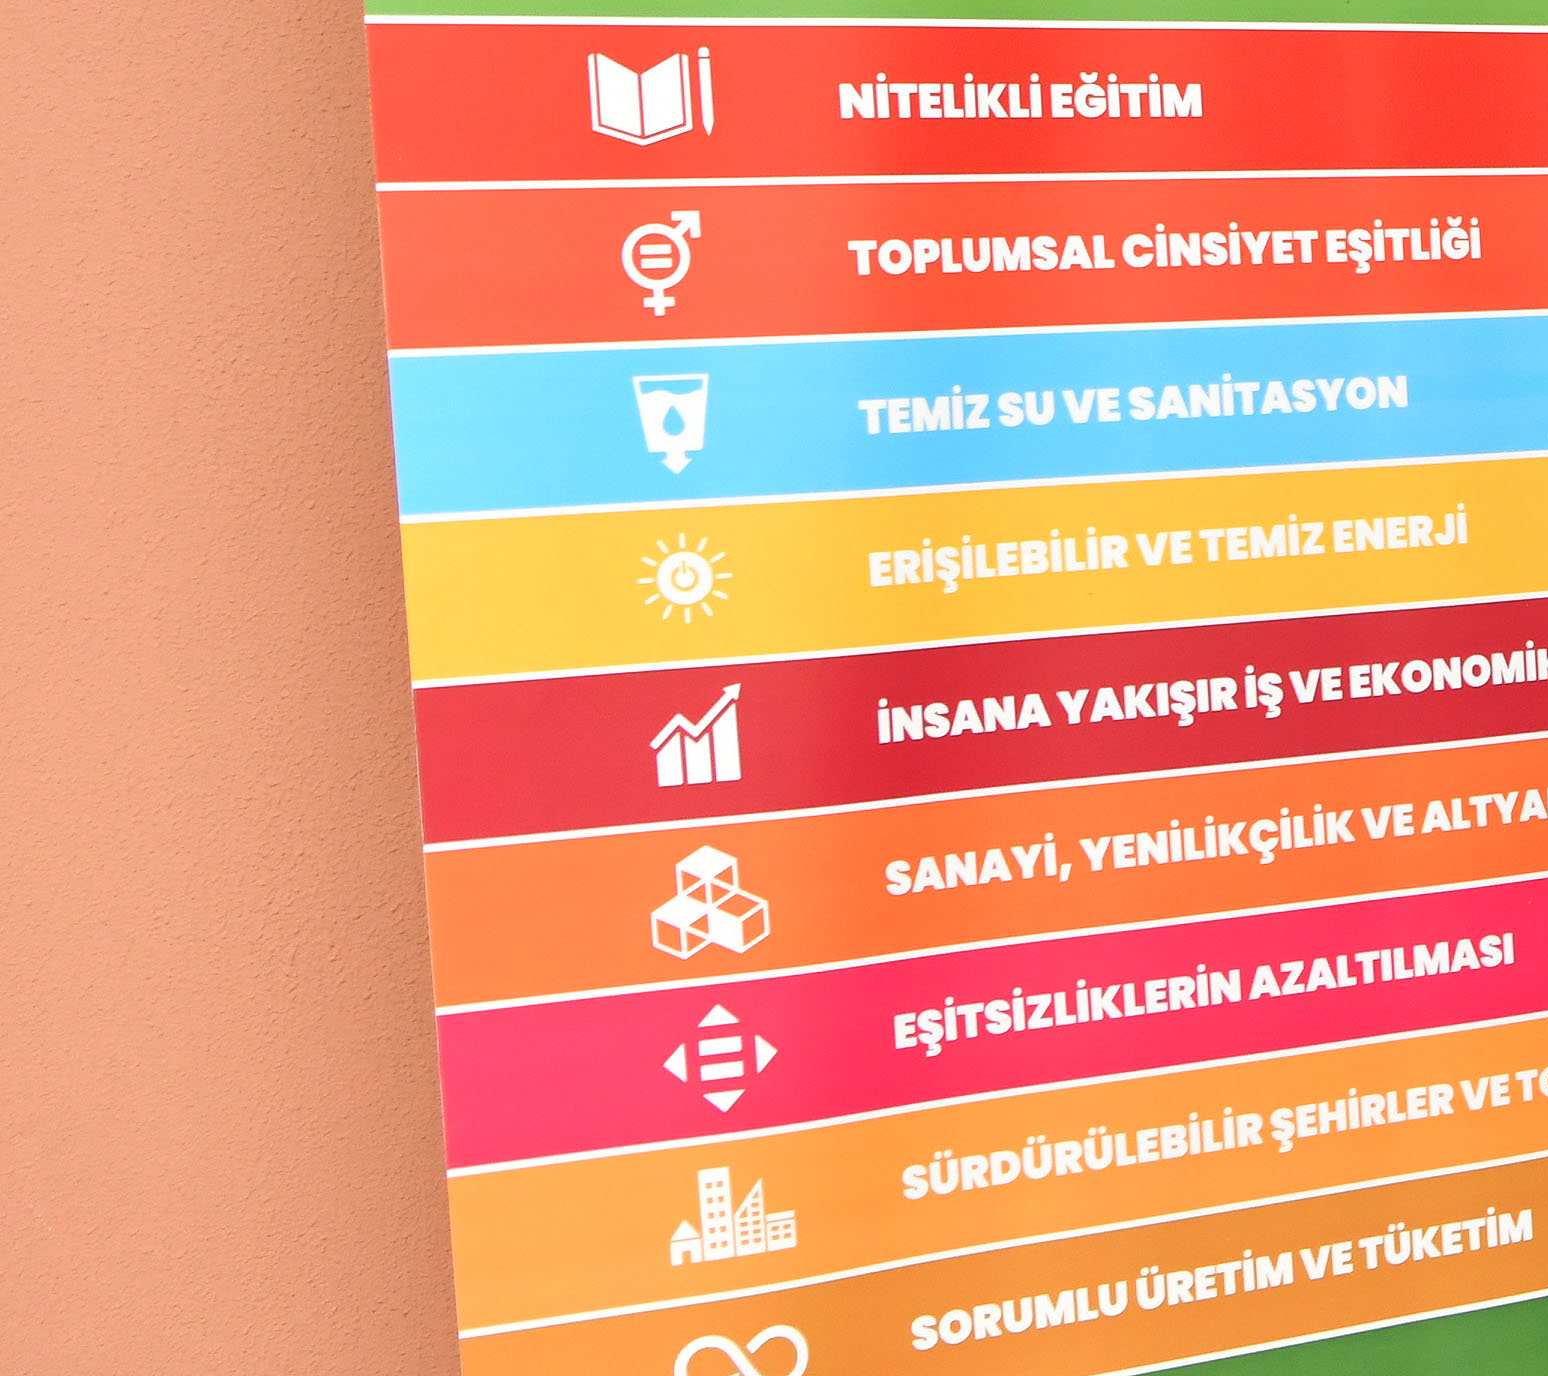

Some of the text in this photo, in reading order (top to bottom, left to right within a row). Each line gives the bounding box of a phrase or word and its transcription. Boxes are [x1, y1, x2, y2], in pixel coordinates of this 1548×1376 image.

[838, 71, 1203, 119] NİTELİKLİ EĞİTİM
[847, 216, 1482, 276] TOPLUMSAL CİNSİYET EŞİTLİĞİ
[857, 372, 1409, 435] TEMİZ SU VE SANİTASYON
[868, 503, 1468, 594] ERİŞİLEBİLİR VE TEMİZ ENERJİ
[877, 693, 1052, 744] İNSANA
[1055, 677, 1238, 727] YAKIŞIR
[1244, 664, 1284, 719] İŞ
[1288, 667, 1343, 704] VE
[885, 832, 1073, 896] SANAYİ,
[1079, 803, 1356, 872] YENİLİKÇİLİK
[1360, 803, 1415, 840] VE
[893, 932, 1515, 1058] EŞİTSİZLİKLERİN AZALTILMASI
[901, 1107, 1264, 1201] SÜRDÜRÜLEBİLİR
[1269, 1083, 1455, 1154] ŞEHİRLER
[1459, 1073, 1511, 1111] VE
[910, 1206, 1534, 1351] SORUMLU ÜRETİM VE TÜKETİM
